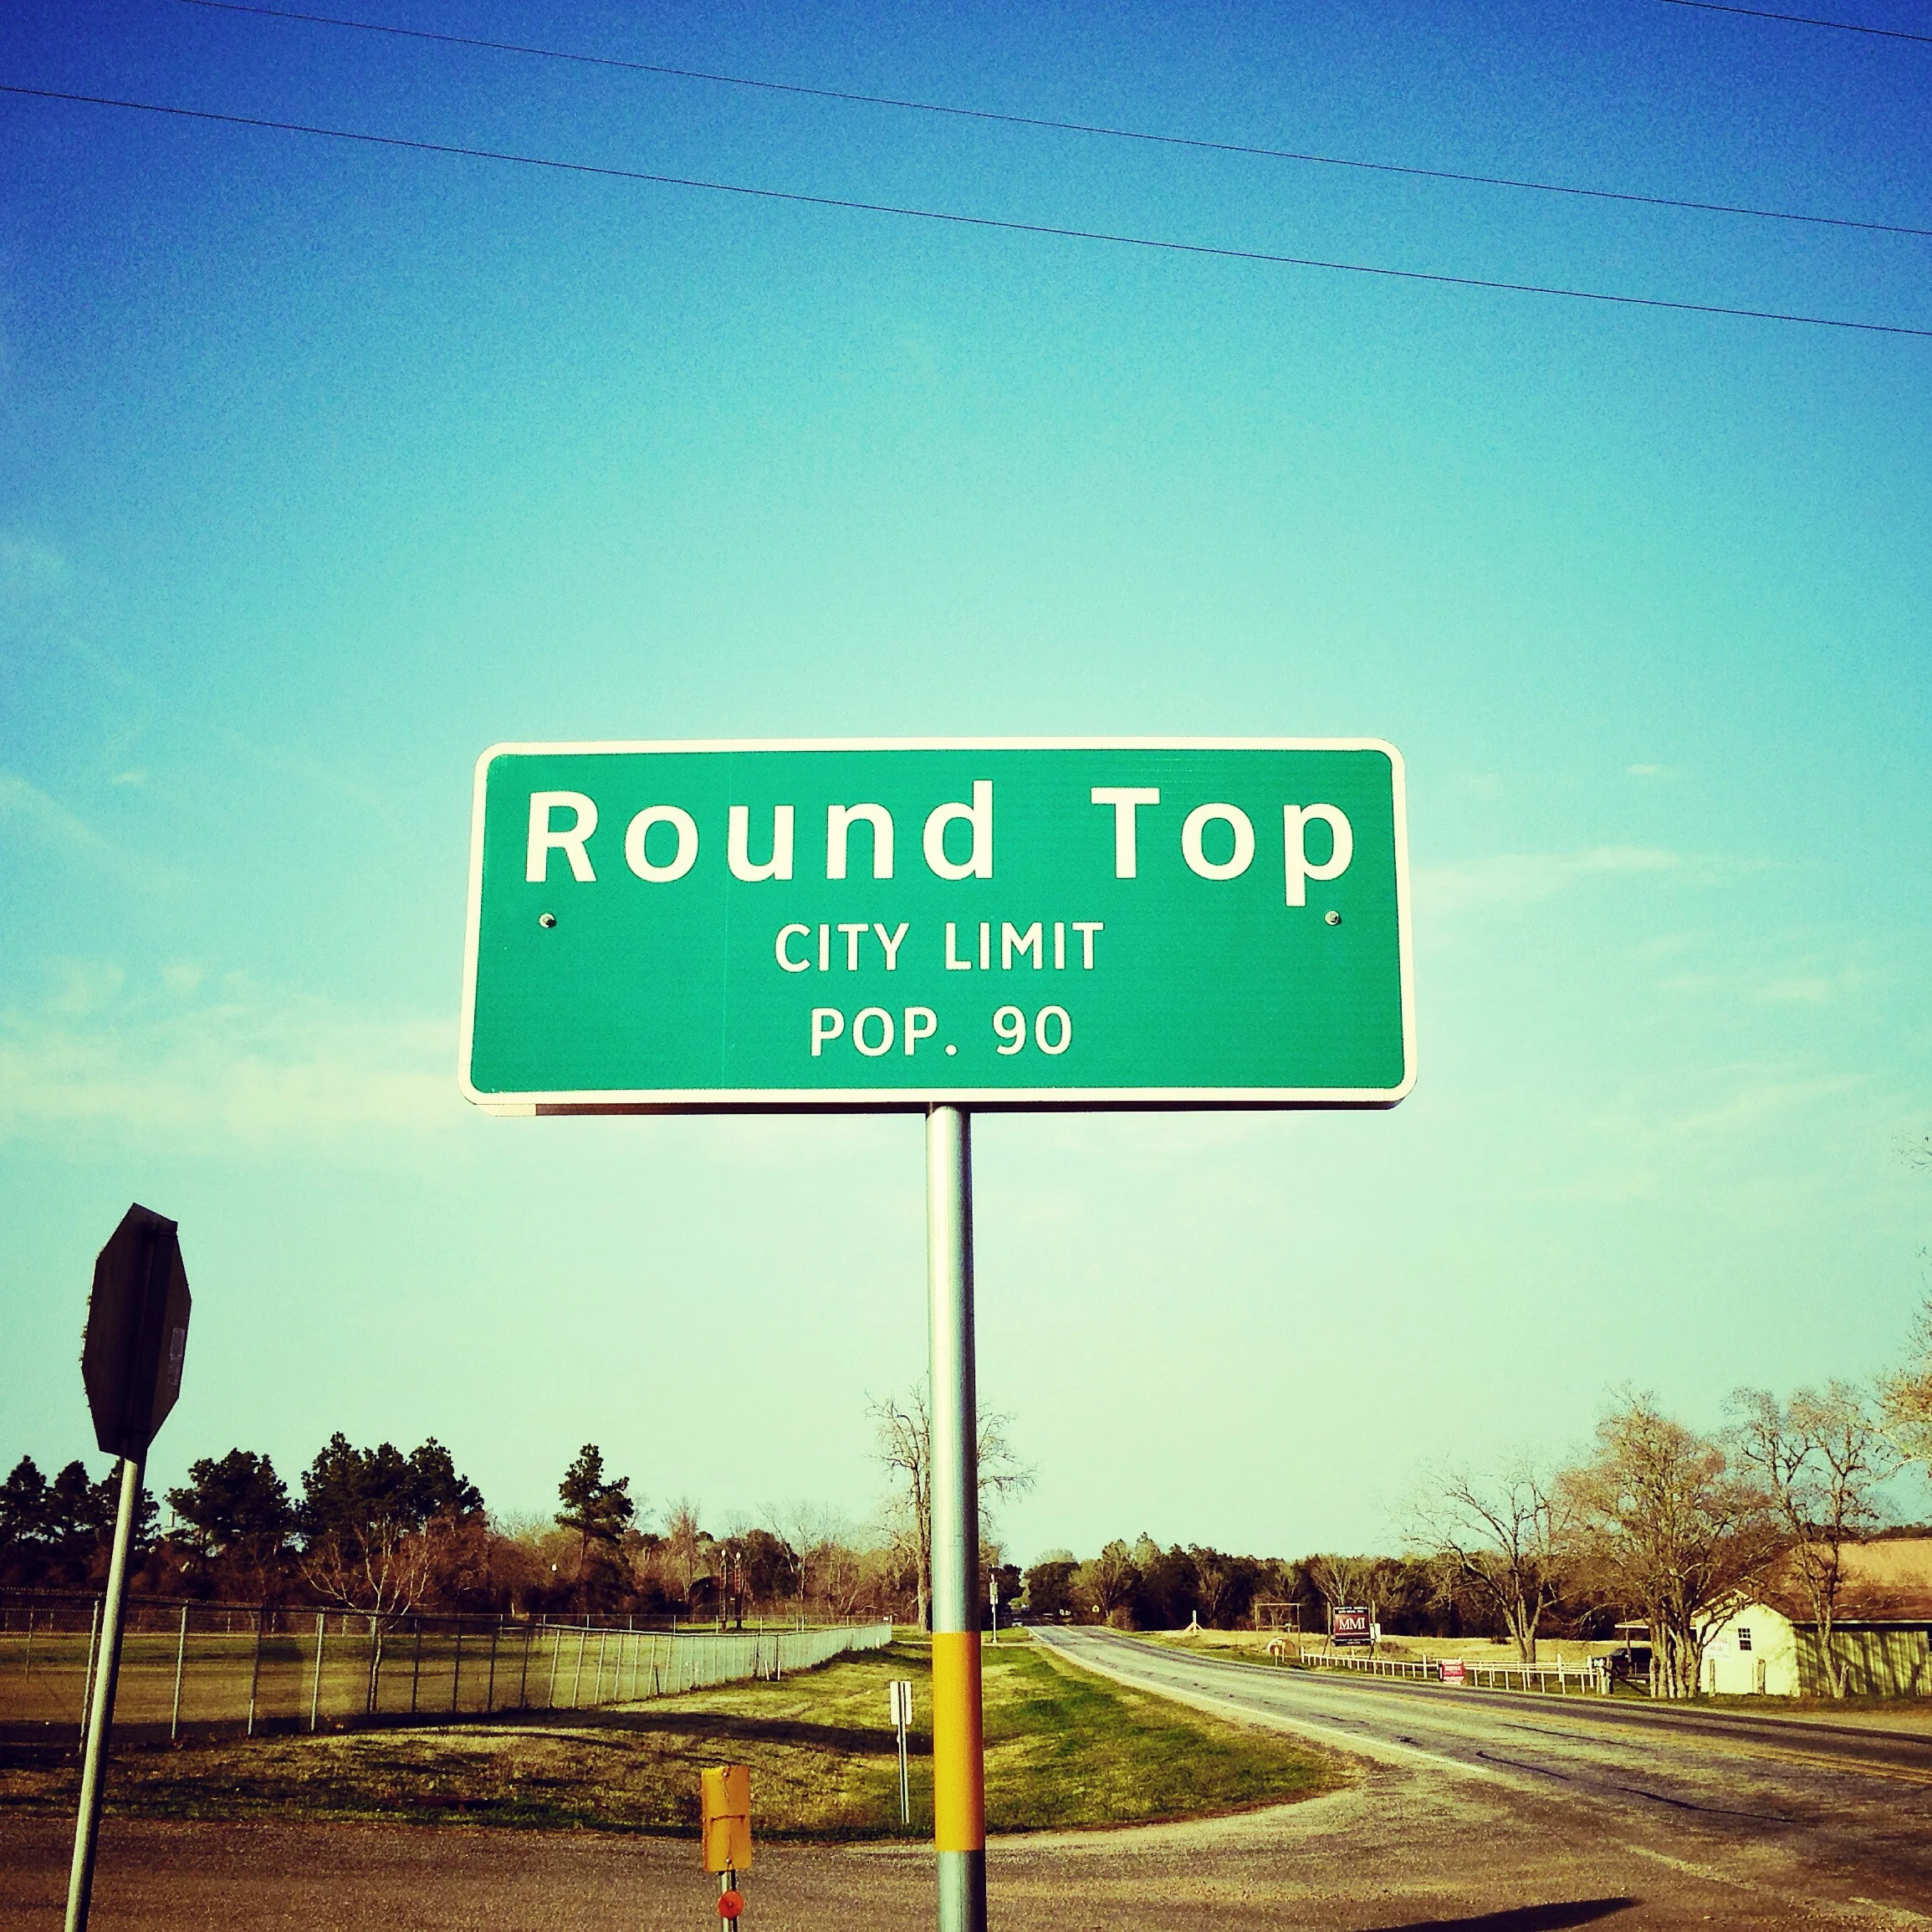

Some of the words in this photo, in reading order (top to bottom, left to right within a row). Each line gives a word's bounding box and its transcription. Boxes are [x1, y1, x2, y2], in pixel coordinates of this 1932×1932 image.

[525, 779, 994, 883] Round
[1091, 786, 1354, 907] Top
[774, 922, 910, 973] CITY
[944, 921, 1105, 971] LIMIT
[810, 1006, 958, 1057] POP.
[992, 1004, 1072, 1055] 90
